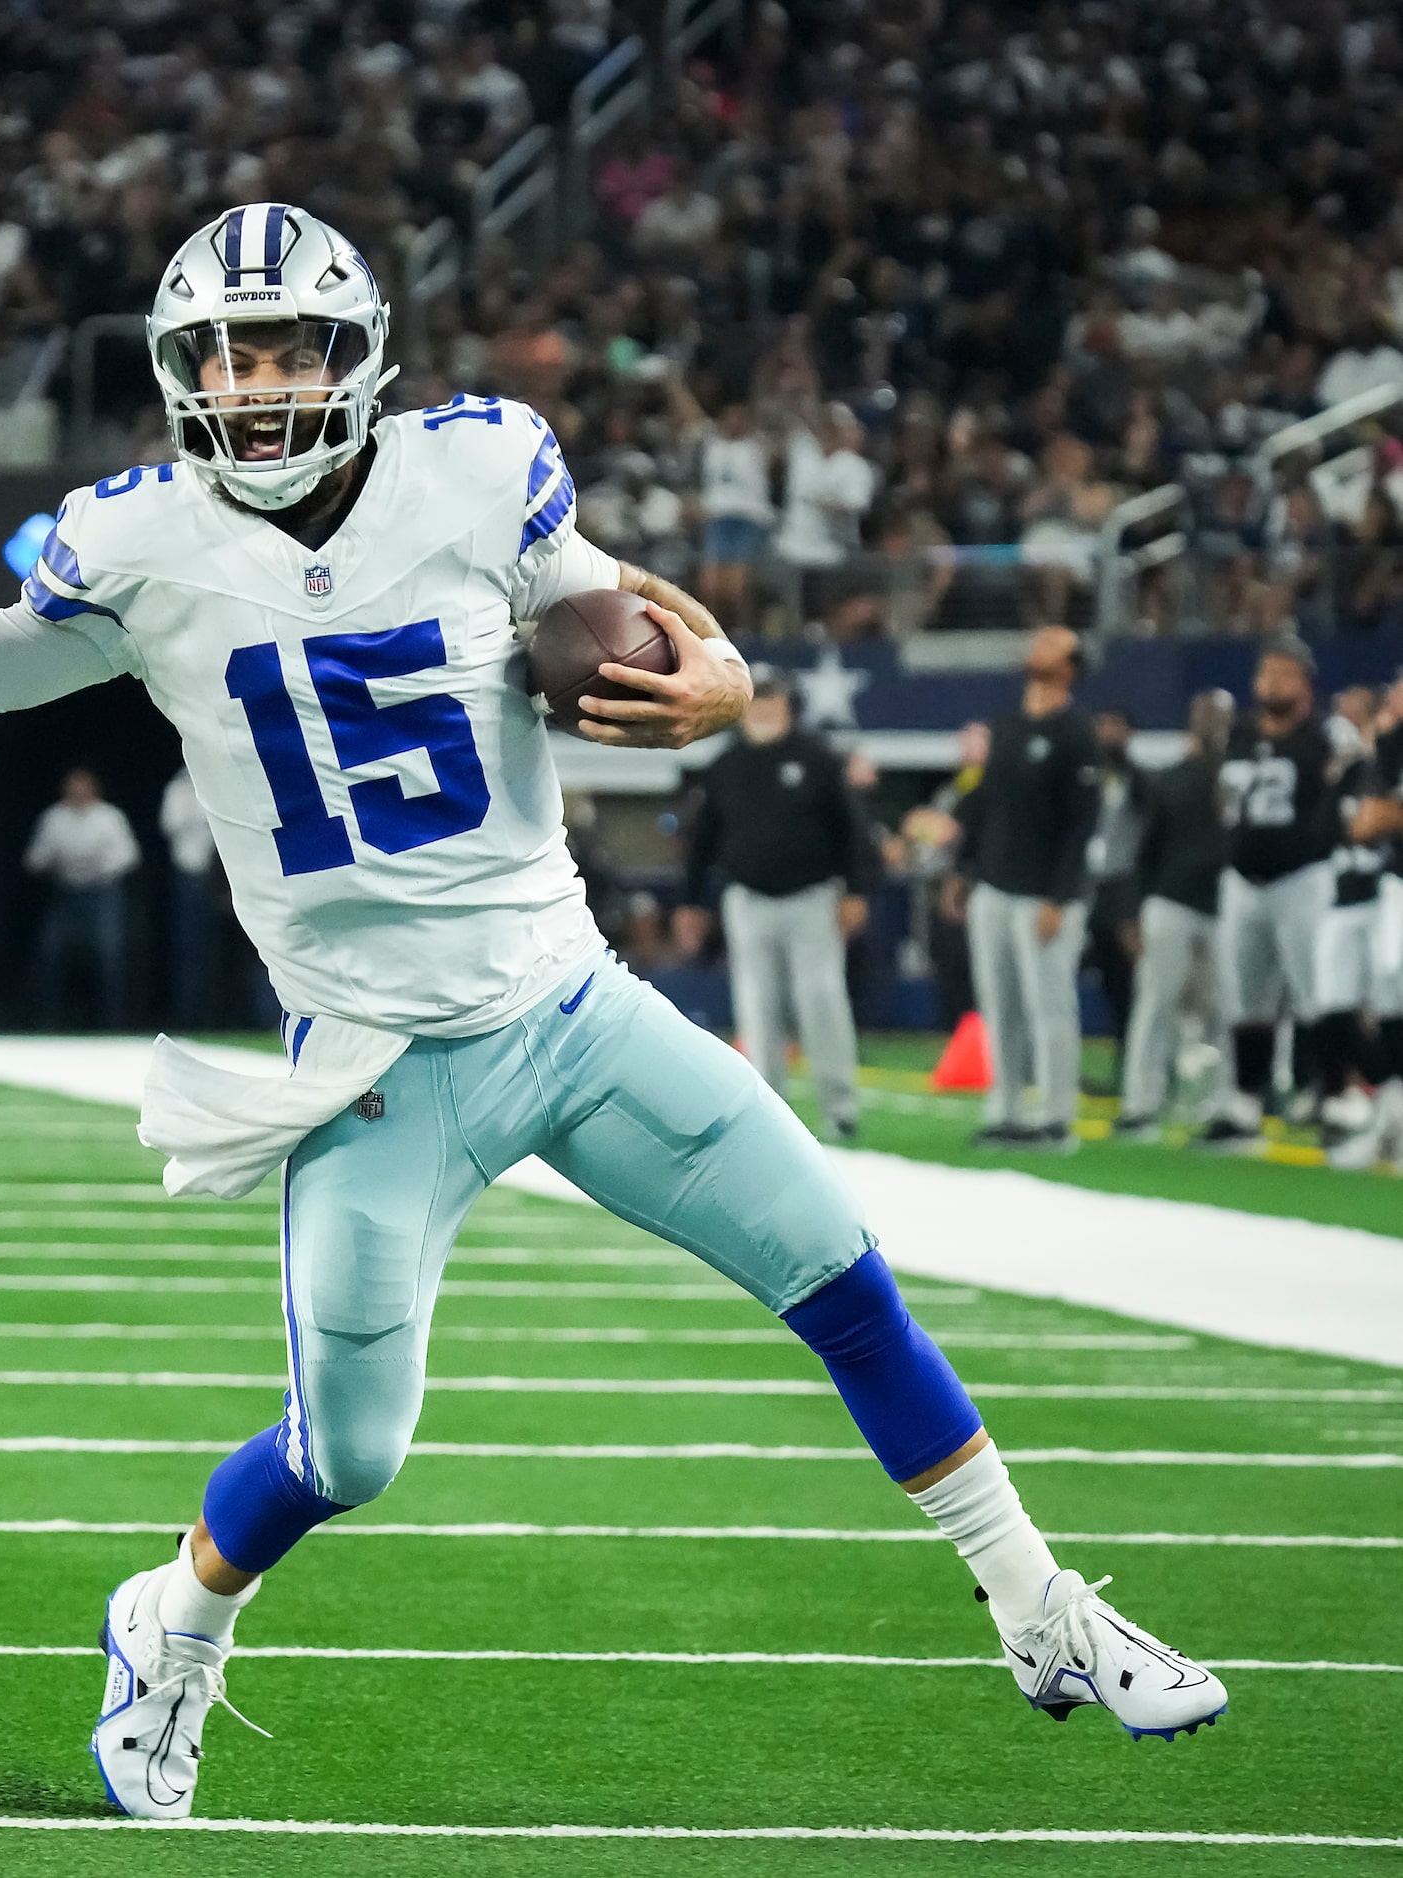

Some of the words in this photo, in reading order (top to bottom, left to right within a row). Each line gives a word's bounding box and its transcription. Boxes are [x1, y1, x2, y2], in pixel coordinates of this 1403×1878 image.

[224, 291, 281, 303] COWBOYS
[308, 578, 330, 592] NFL
[224, 617, 492, 877] 15
[1219, 757, 1297, 827] 72
[359, 1102, 382, 1117] NFL
